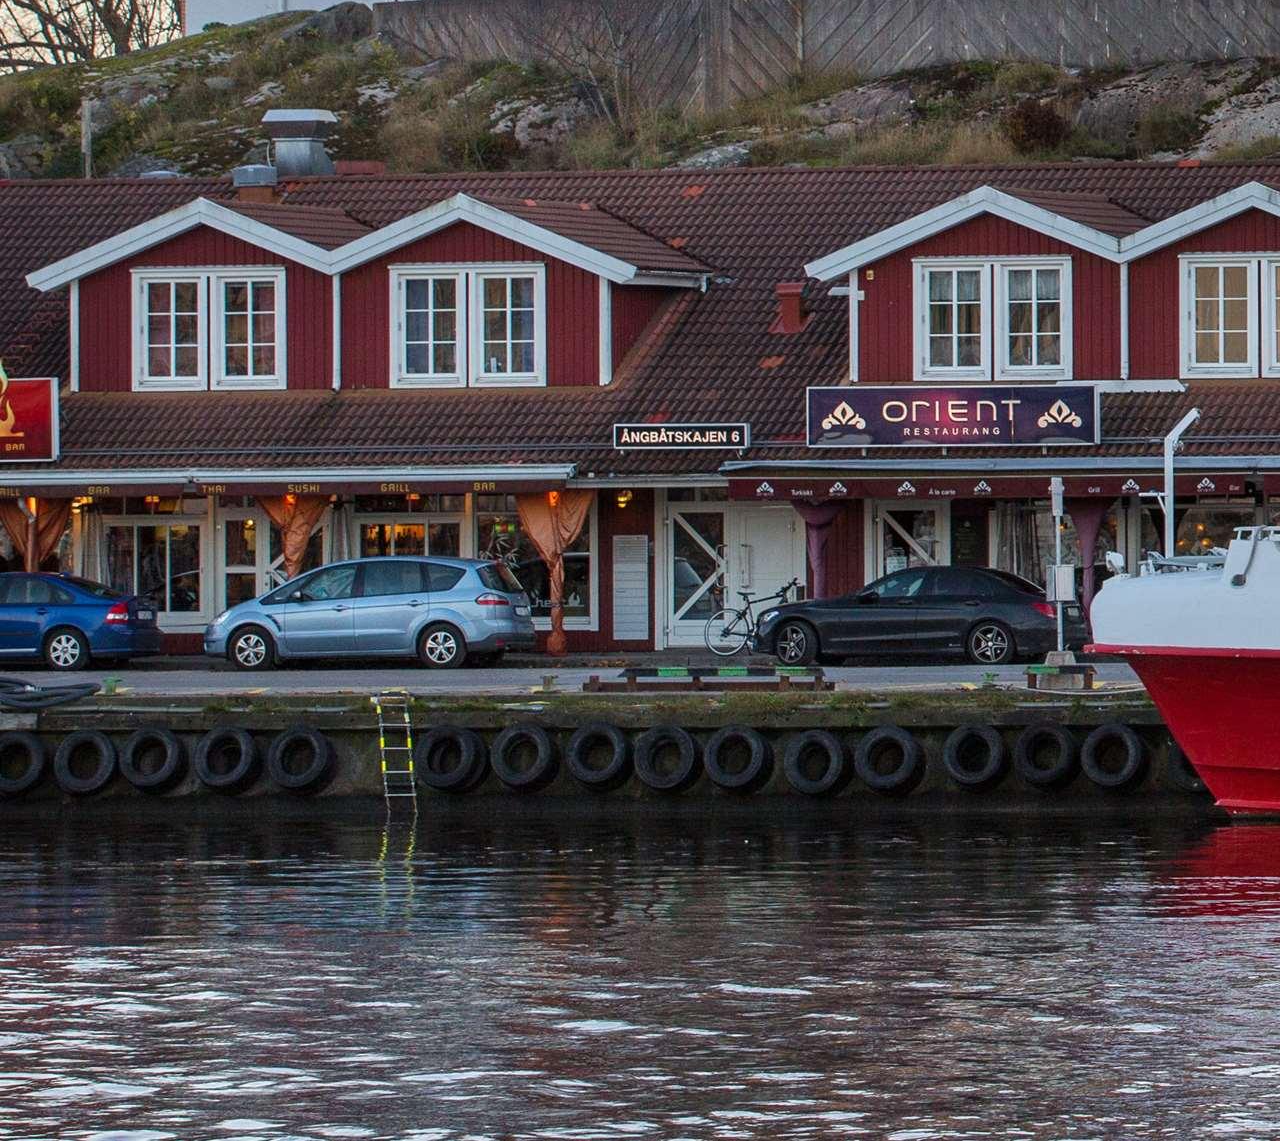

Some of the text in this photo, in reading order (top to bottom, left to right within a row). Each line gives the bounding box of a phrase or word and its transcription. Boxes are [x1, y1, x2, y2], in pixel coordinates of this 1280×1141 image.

[882, 400, 1021, 422] ORIENT
[621, 428, 740, 443] ÅNGBÅTSKAJEN 6
[903, 427, 1001, 436] RESTAURANG
[287, 484, 320, 493] SUSHI
[380, 484, 410, 493] GRILL
